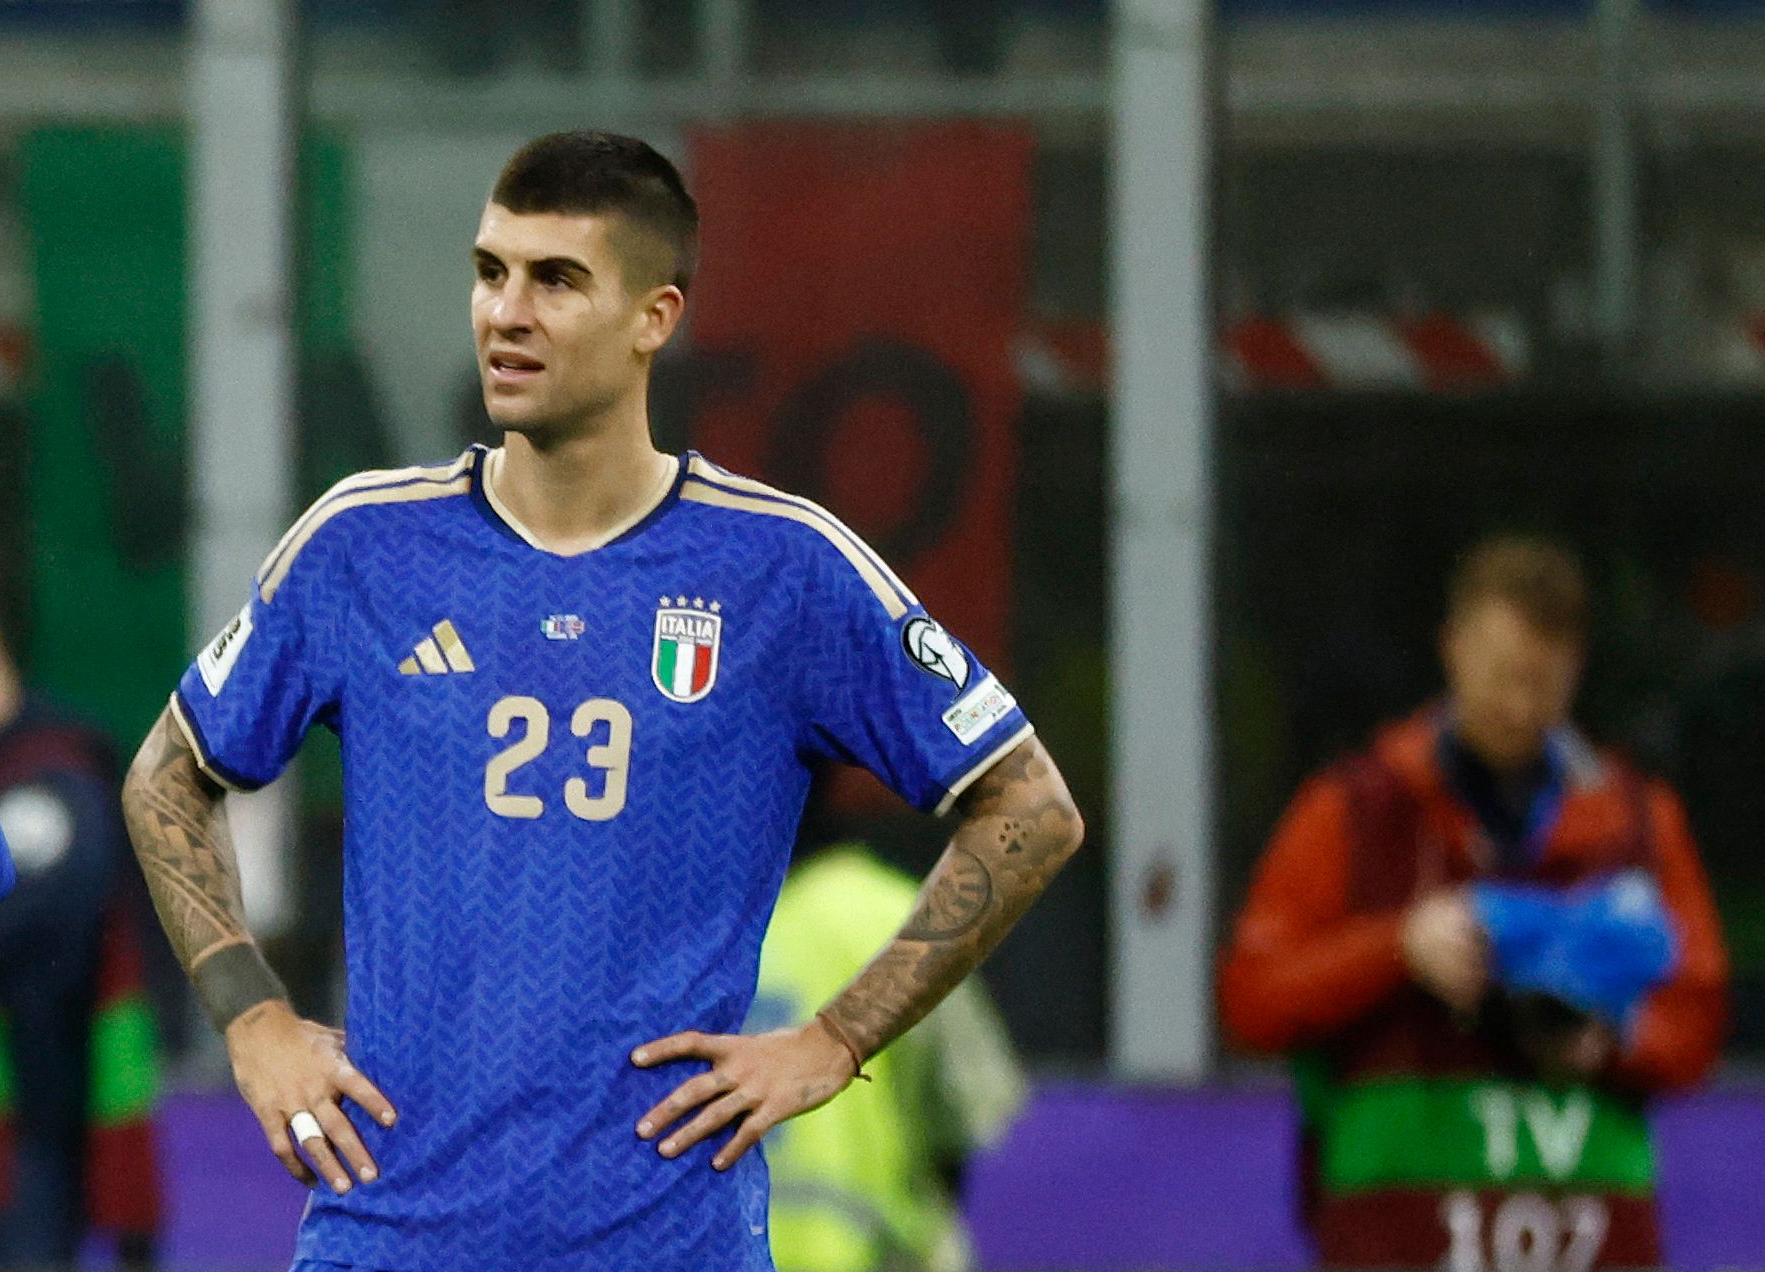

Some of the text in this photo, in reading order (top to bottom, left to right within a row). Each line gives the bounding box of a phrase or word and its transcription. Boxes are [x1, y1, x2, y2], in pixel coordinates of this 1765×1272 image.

[661, 616, 714, 640] ITALIA
[485, 695, 632, 821] 23
[1470, 1085, 1592, 1182] TV
